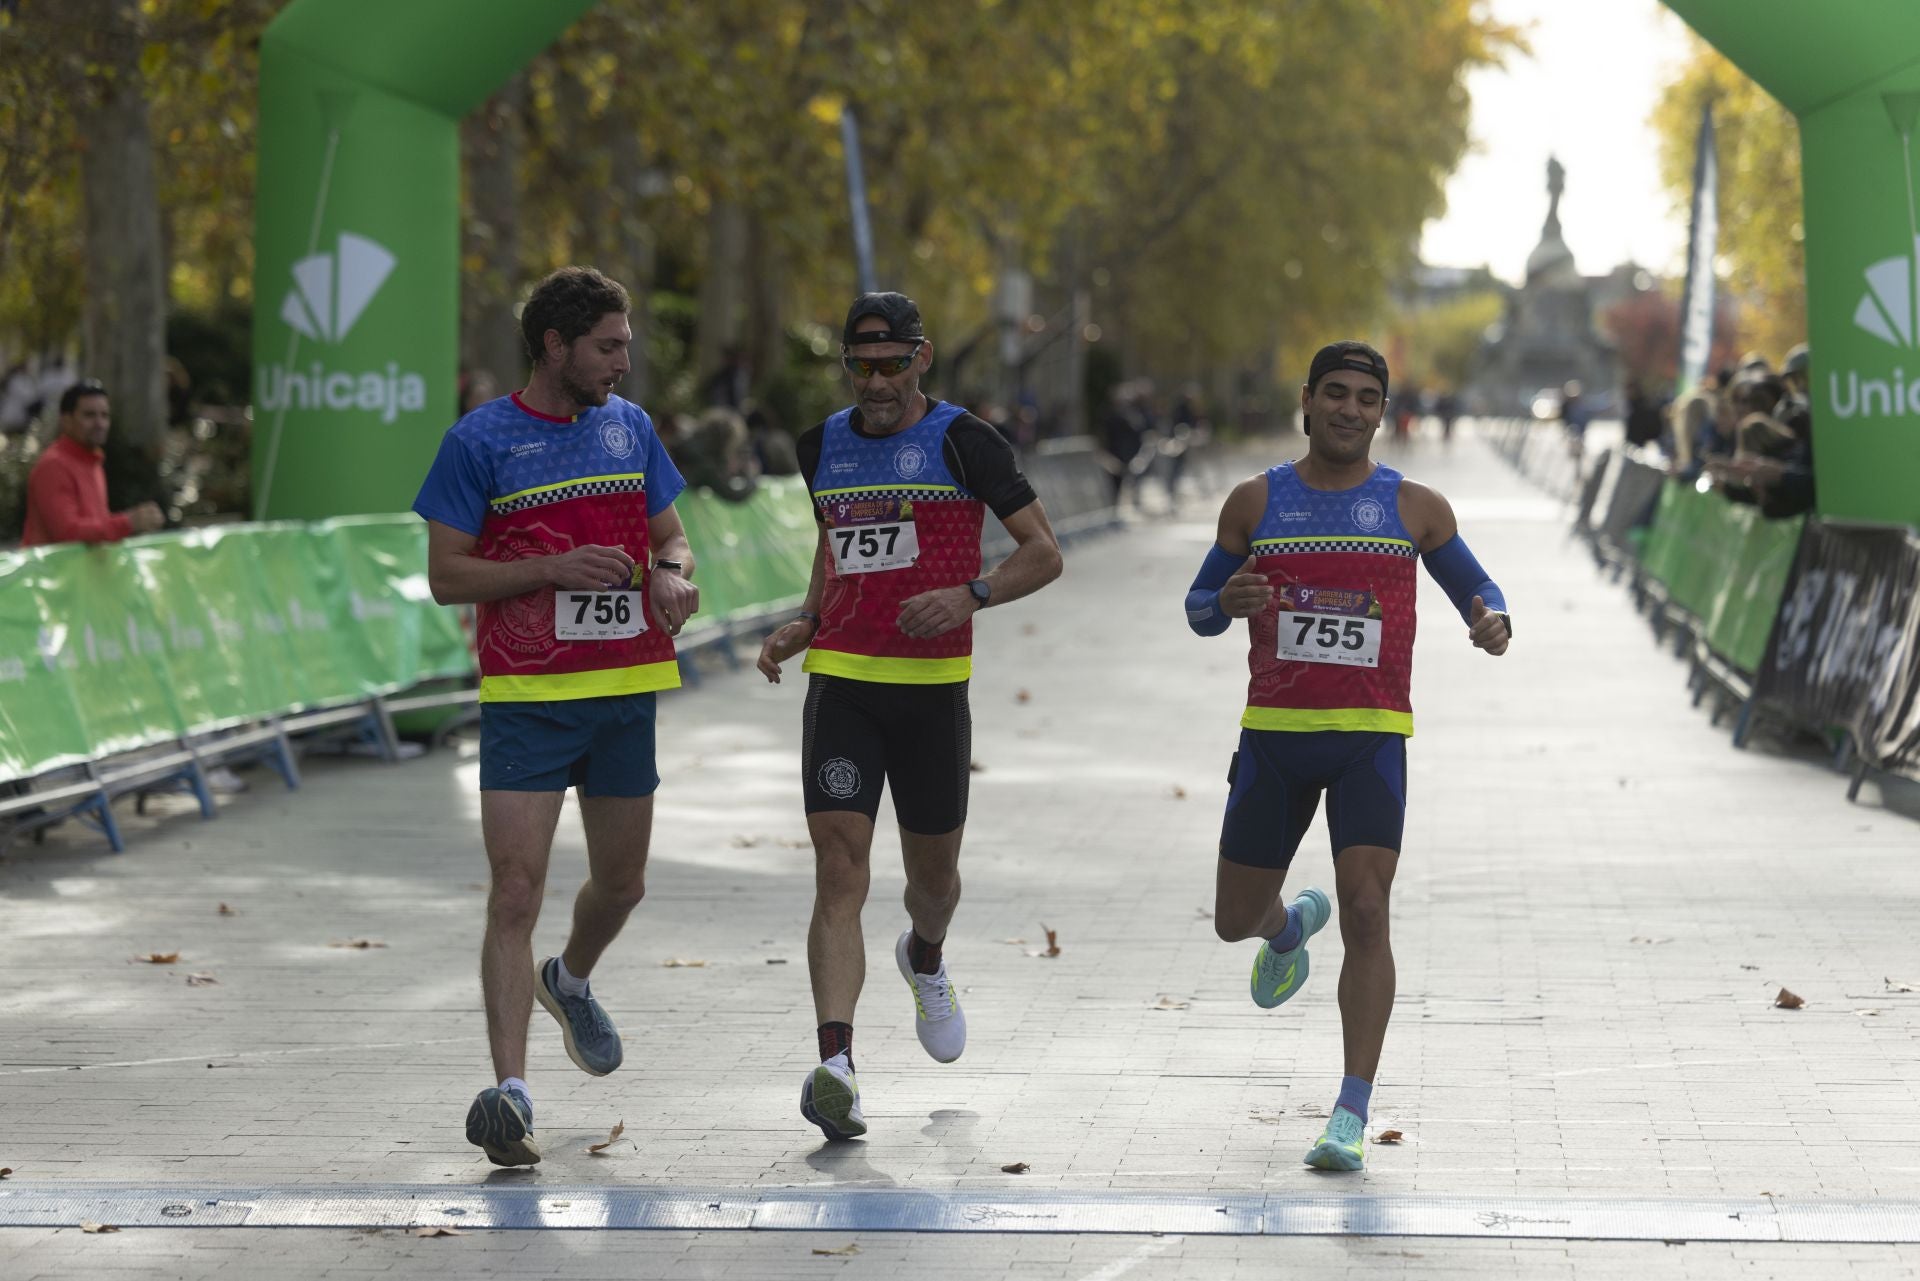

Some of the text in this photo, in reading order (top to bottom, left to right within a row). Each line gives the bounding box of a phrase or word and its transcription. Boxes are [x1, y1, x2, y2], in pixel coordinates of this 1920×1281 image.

[256, 362, 426, 424] Unicaja
[851, 508, 884, 518] EMPRESAS
[836, 526, 900, 560] 757
[570, 594, 630, 625] 756
[1313, 597, 1352, 608] EMPRESAS
[1293, 615, 1365, 651] 755
